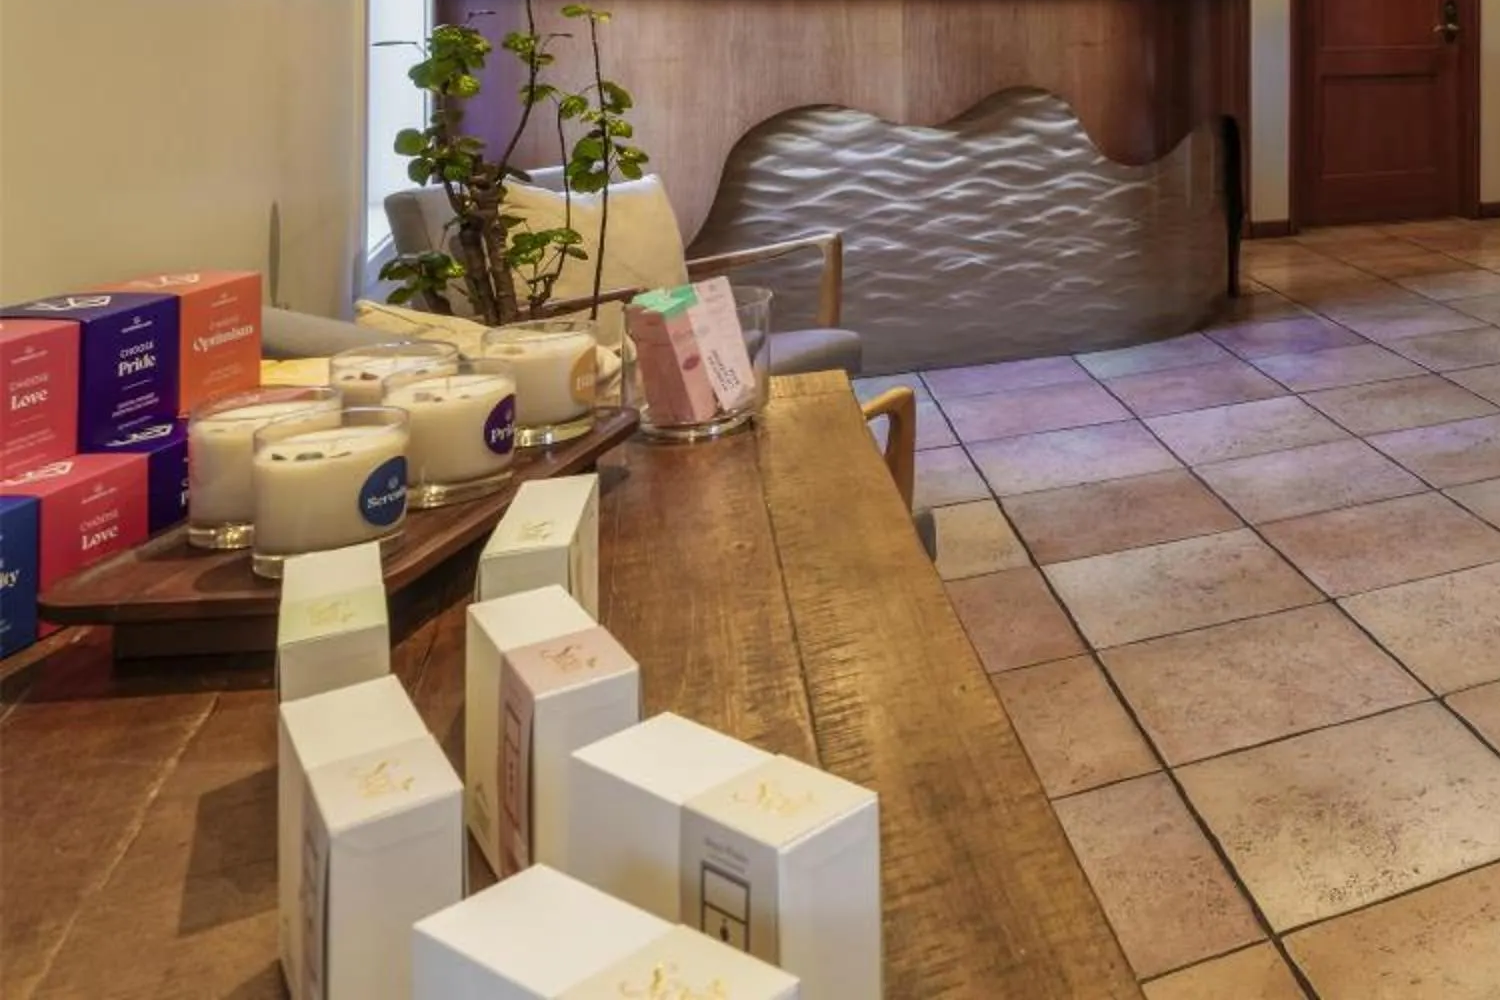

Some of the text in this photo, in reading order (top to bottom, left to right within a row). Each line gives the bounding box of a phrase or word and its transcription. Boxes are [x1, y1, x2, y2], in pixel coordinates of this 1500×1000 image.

[117, 353, 157, 377] Pride
[10, 388, 49, 411] Love
[81, 525, 120, 551] Love
